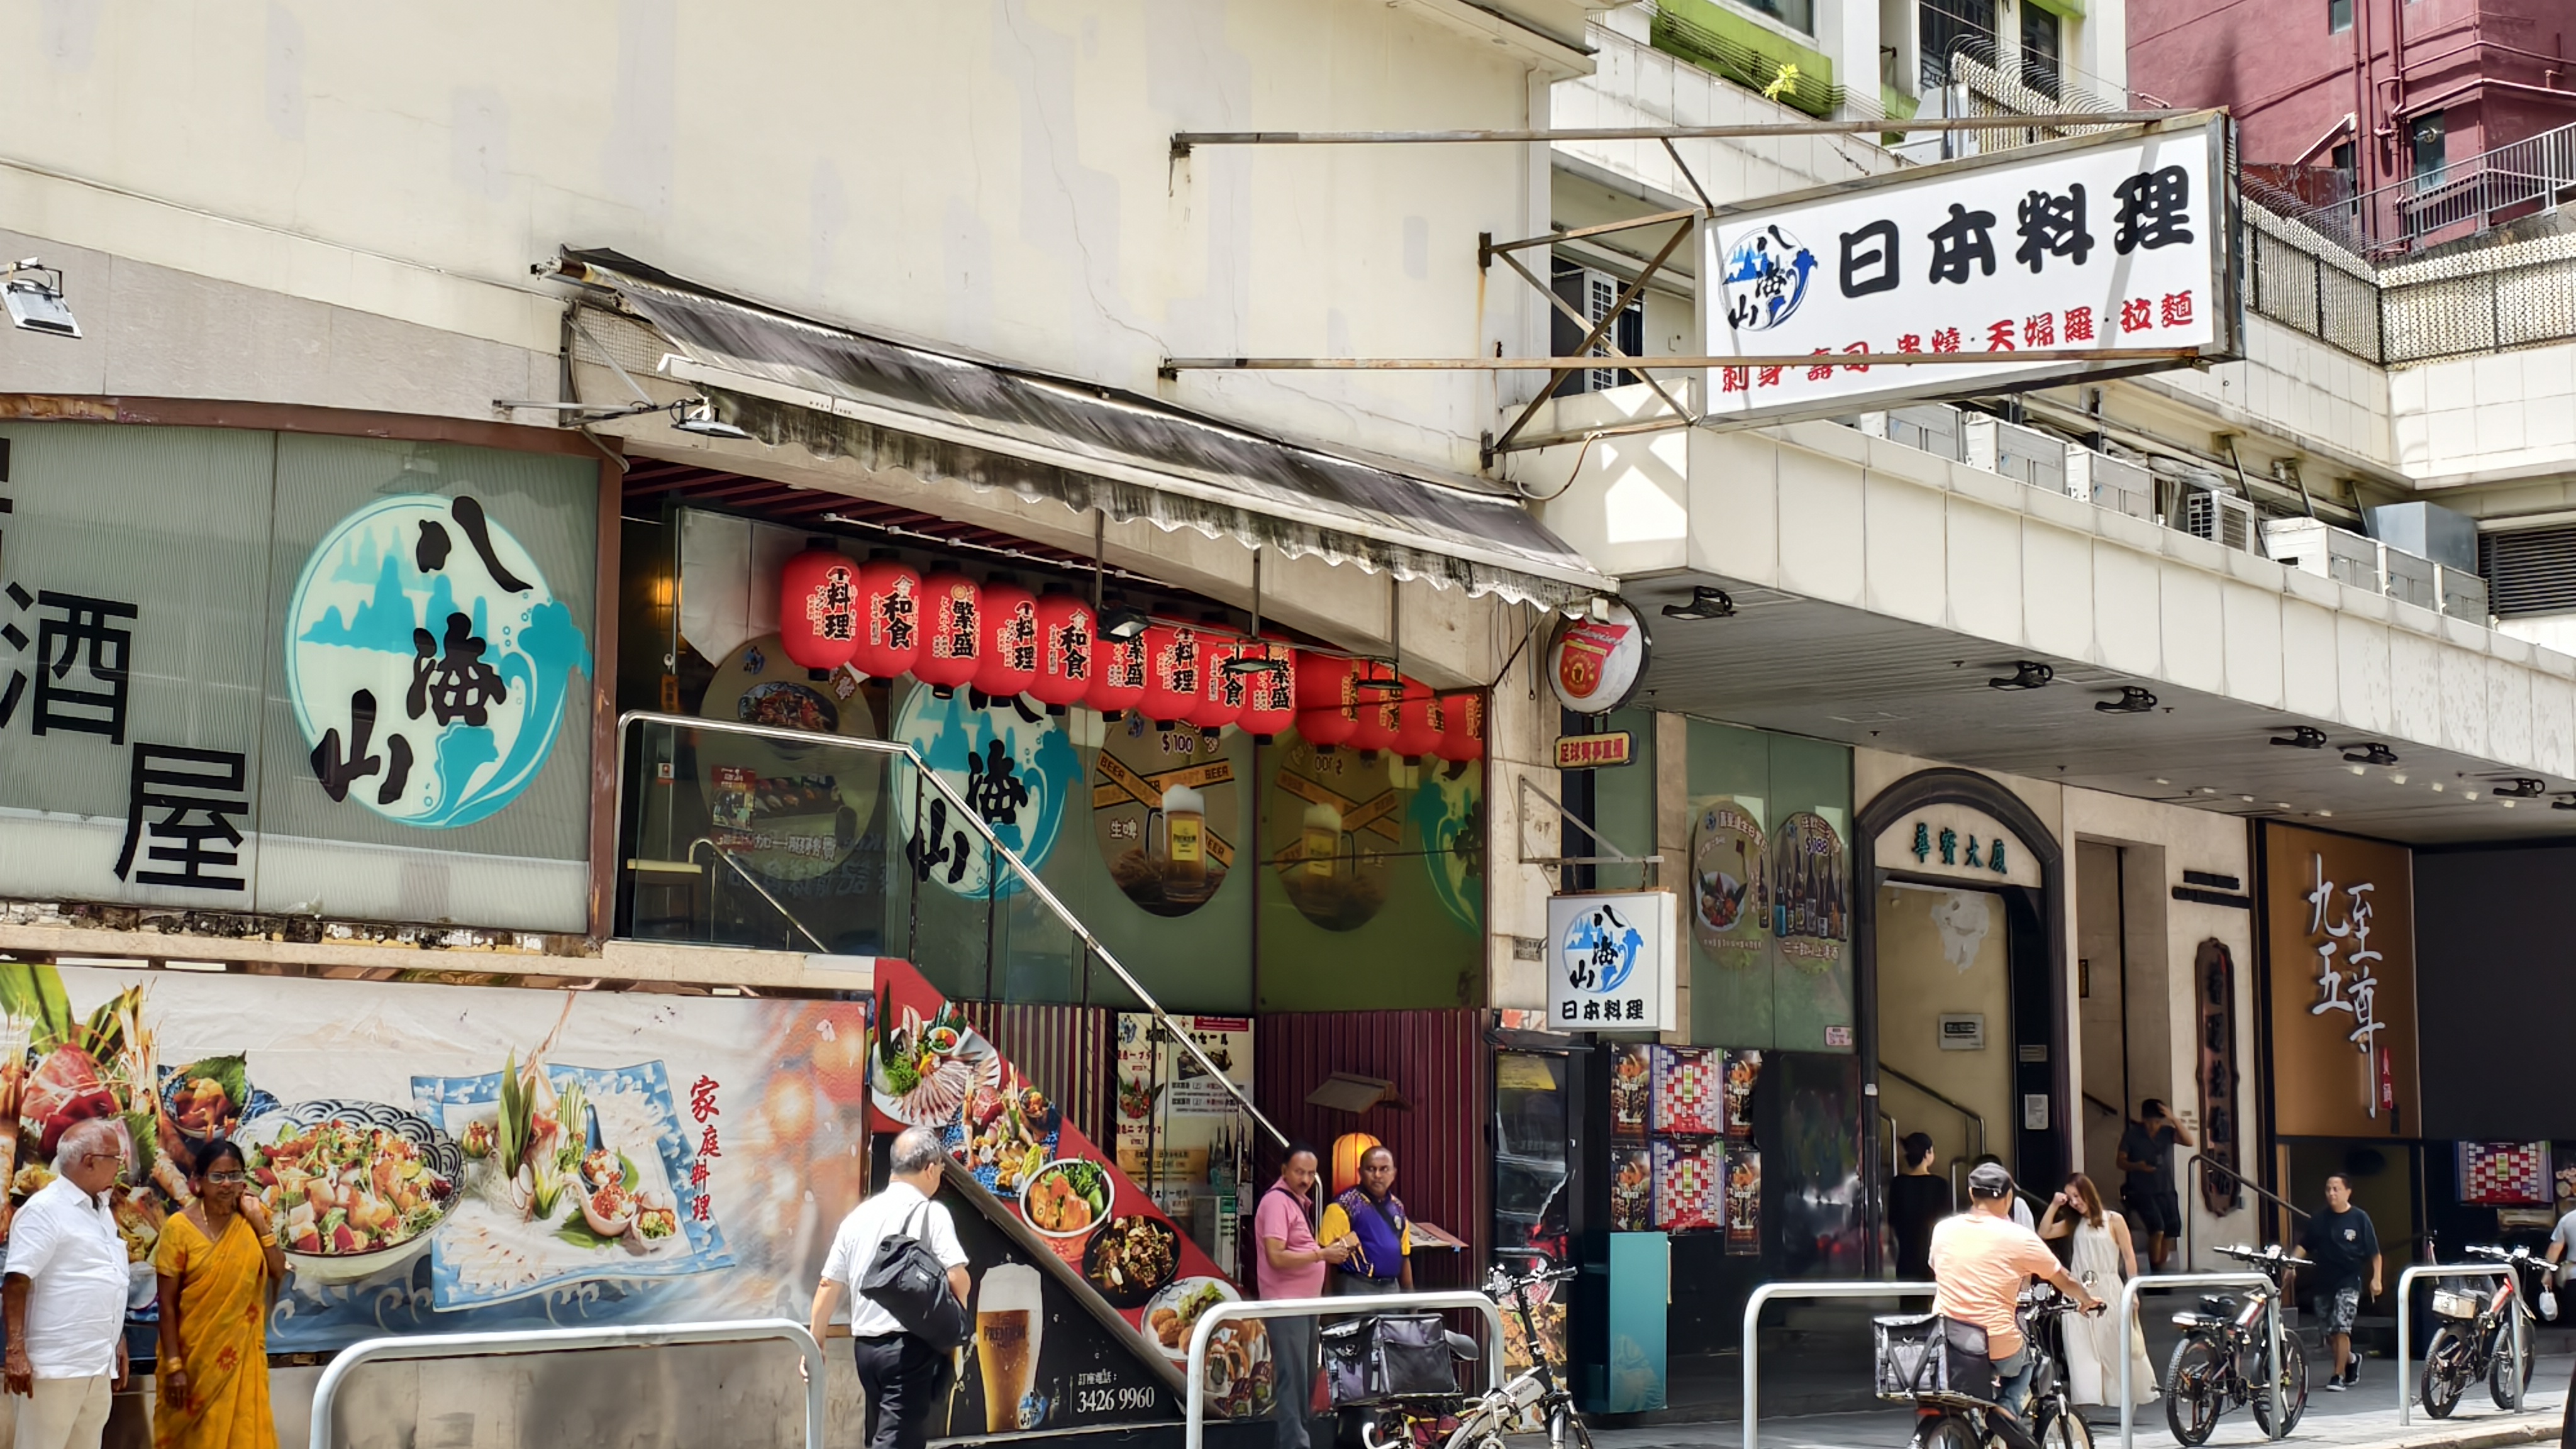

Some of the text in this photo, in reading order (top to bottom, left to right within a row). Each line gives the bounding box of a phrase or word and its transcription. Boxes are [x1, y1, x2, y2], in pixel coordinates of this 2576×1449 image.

[1840, 165, 2194, 299] 日本料理
[1728, 224, 1797, 330] 八海山
[2119, 289, 2193, 333] 拉麵
[823, 582, 852, 640] 料理
[882, 592, 914, 648] 和食
[311, 496, 533, 804] 八海山
[1101, 756, 1125, 779] BEER
[1204, 765, 1229, 779] BEER
[1570, 904, 1626, 989] 八海山
[1562, 999, 1645, 1021] 日本料理
[690, 1074, 722, 1221] 家庭料理
[1077, 1389, 1115, 1413] 3426
[1118, 1385, 1155, 1411] 9960
